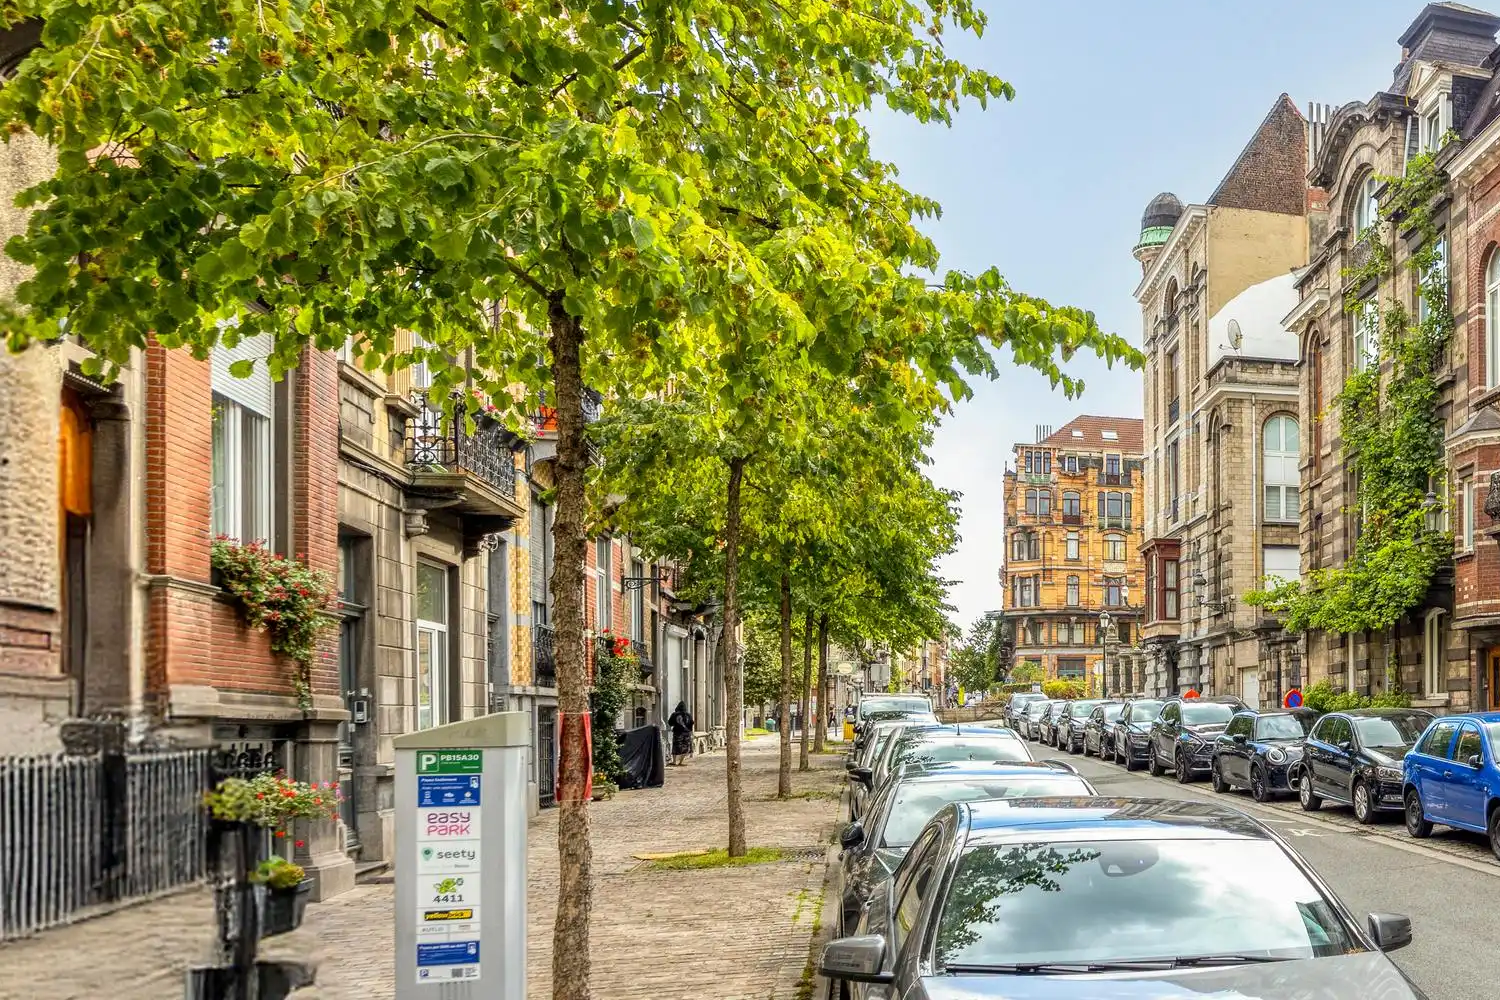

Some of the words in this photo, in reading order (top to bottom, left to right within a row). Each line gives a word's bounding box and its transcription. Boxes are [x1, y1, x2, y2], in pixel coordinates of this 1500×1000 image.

[421, 754, 437, 770] P
[427, 812, 470, 824] easy
[437, 849, 475, 860] seety
[433, 894, 464, 903] 4411
